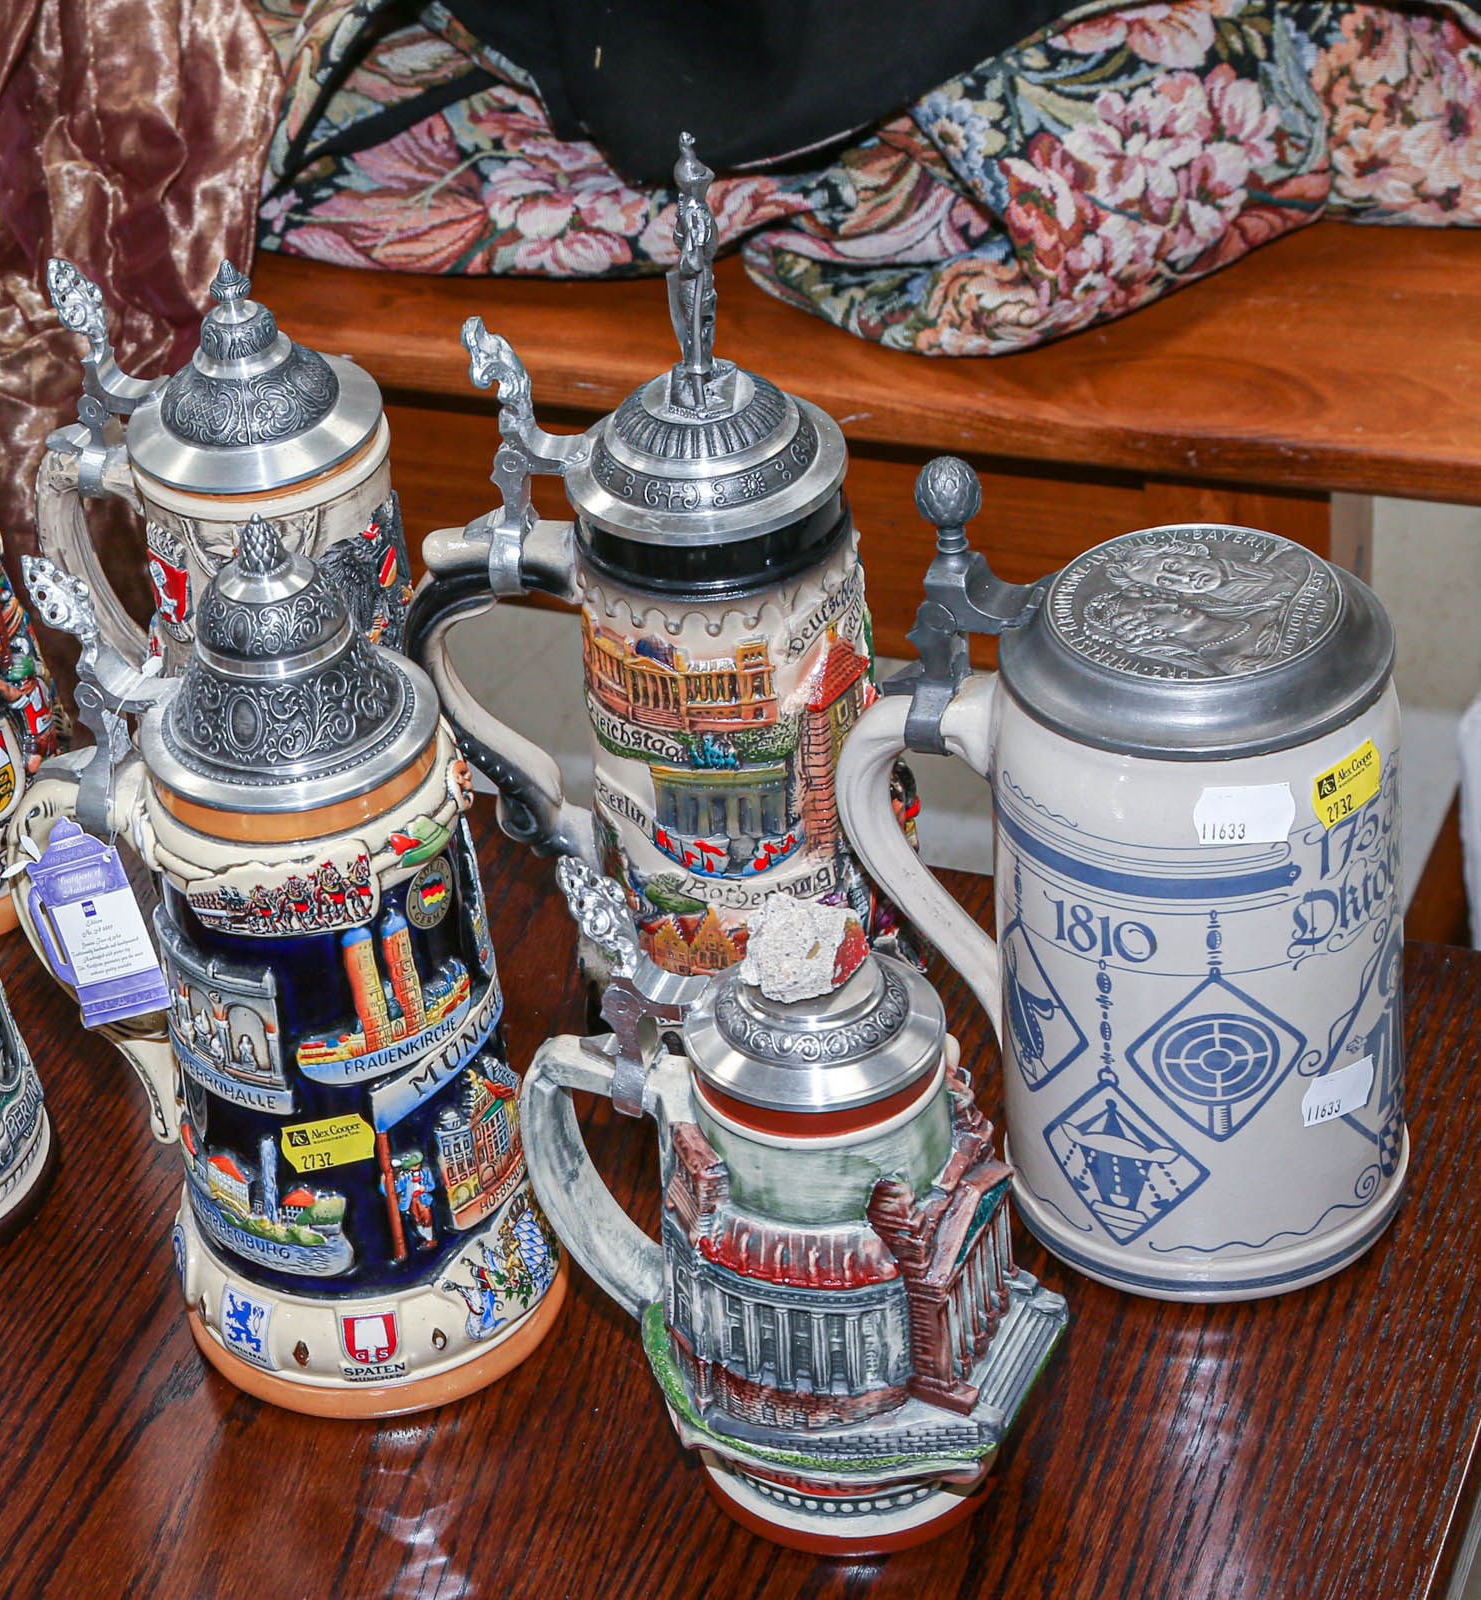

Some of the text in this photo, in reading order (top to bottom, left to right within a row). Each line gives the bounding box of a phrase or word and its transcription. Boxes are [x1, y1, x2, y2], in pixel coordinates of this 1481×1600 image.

[1192, 529, 1269, 552] BAYERN
[1337, 766, 1353, 784] Alex
[1351, 749, 1374, 771] Cooper
[1326, 793, 1356, 824] 2732
[1201, 822, 1247, 841] 11633
[1043, 890, 1158, 963] 1810
[343, 1014, 458, 1076] FRAUENKIRCHE
[4, 1076, 42, 1141] BERLIN
[1306, 1099, 1343, 1123] 11633
[311, 1128, 330, 1139] Alex
[329, 1122, 361, 1135] Cooper
[301, 1151, 335, 1170] 2732
[344, 1362, 406, 1377] SPATEN
